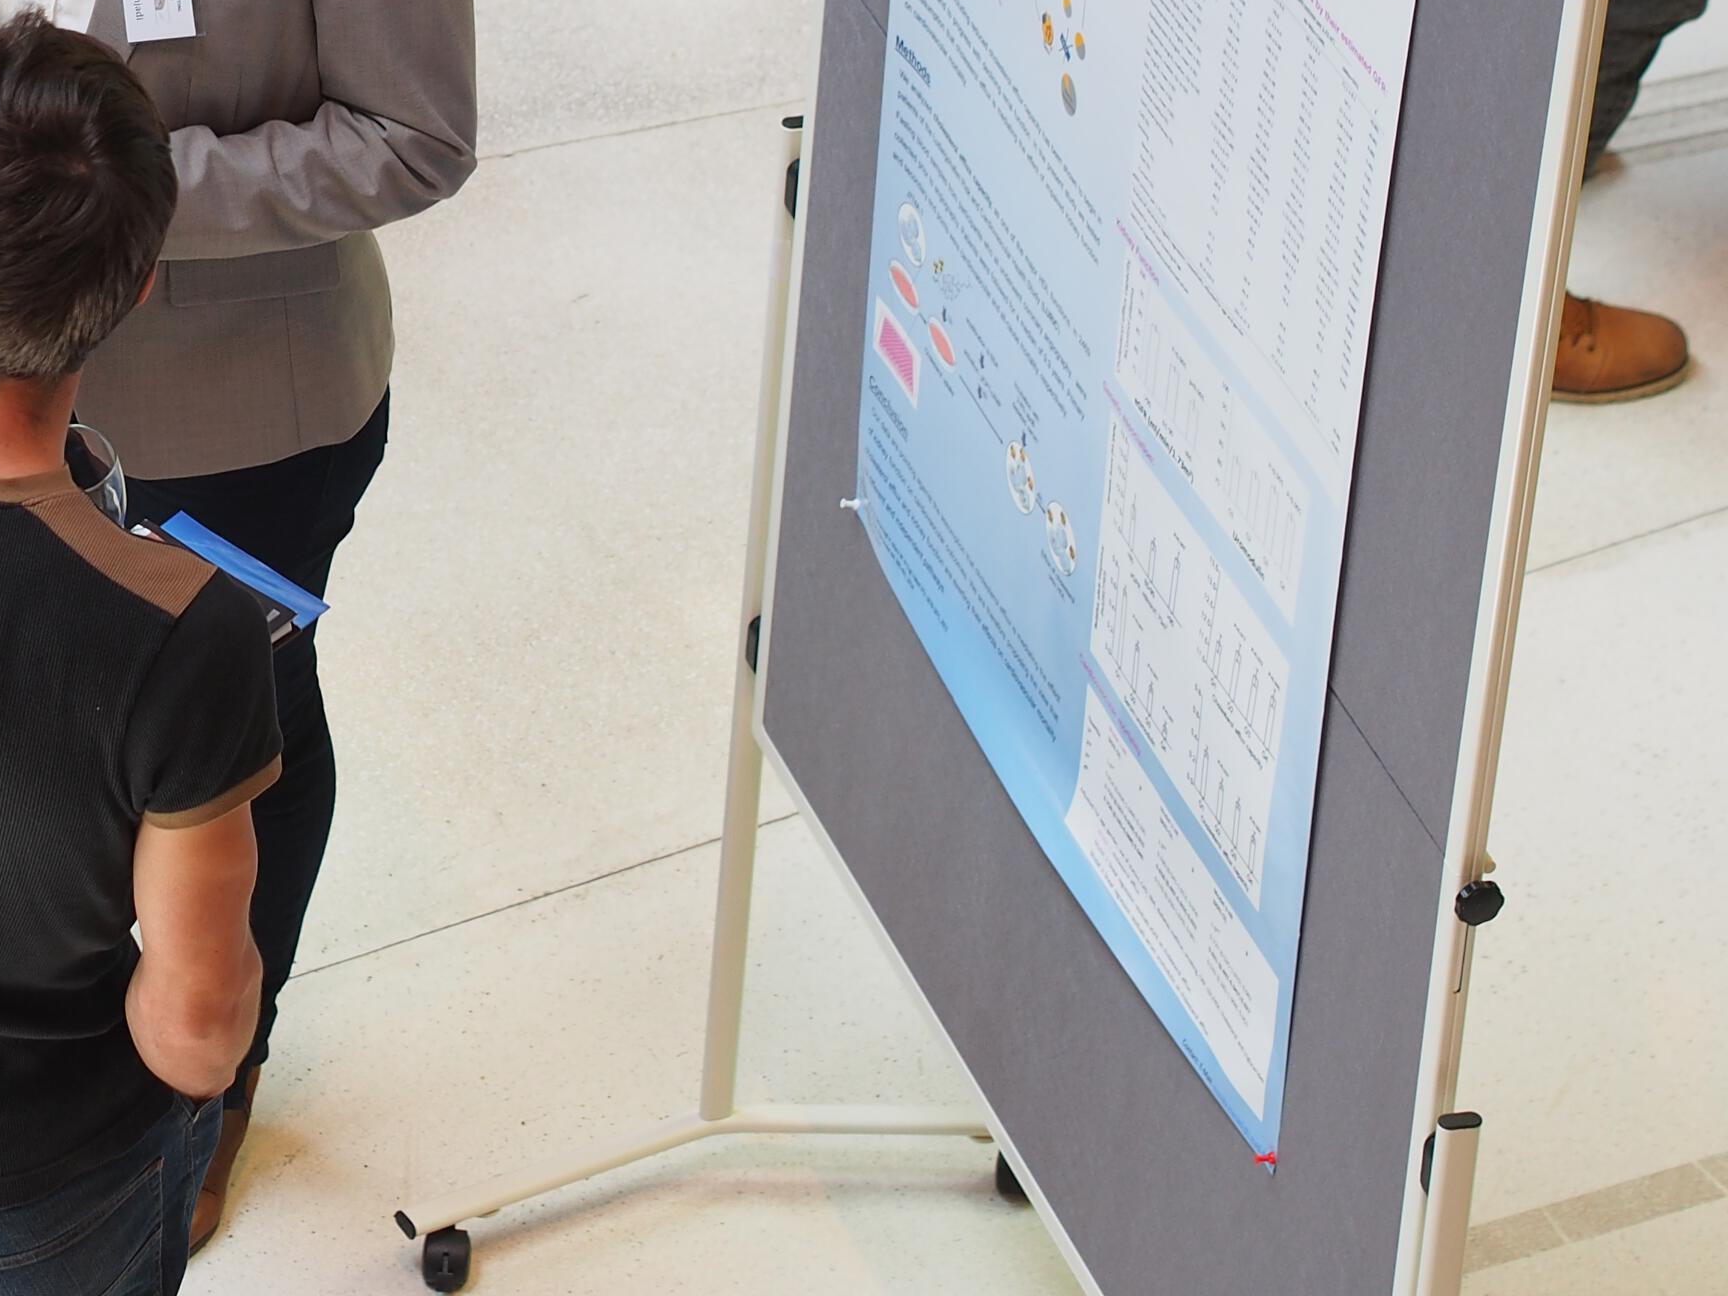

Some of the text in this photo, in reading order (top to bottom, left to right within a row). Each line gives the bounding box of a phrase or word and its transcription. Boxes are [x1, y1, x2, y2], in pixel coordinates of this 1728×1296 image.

[895, 26, 932, 91] Methods
[1324, 9, 1341, 37] their
[1340, 28, 1373, 78] estimated
